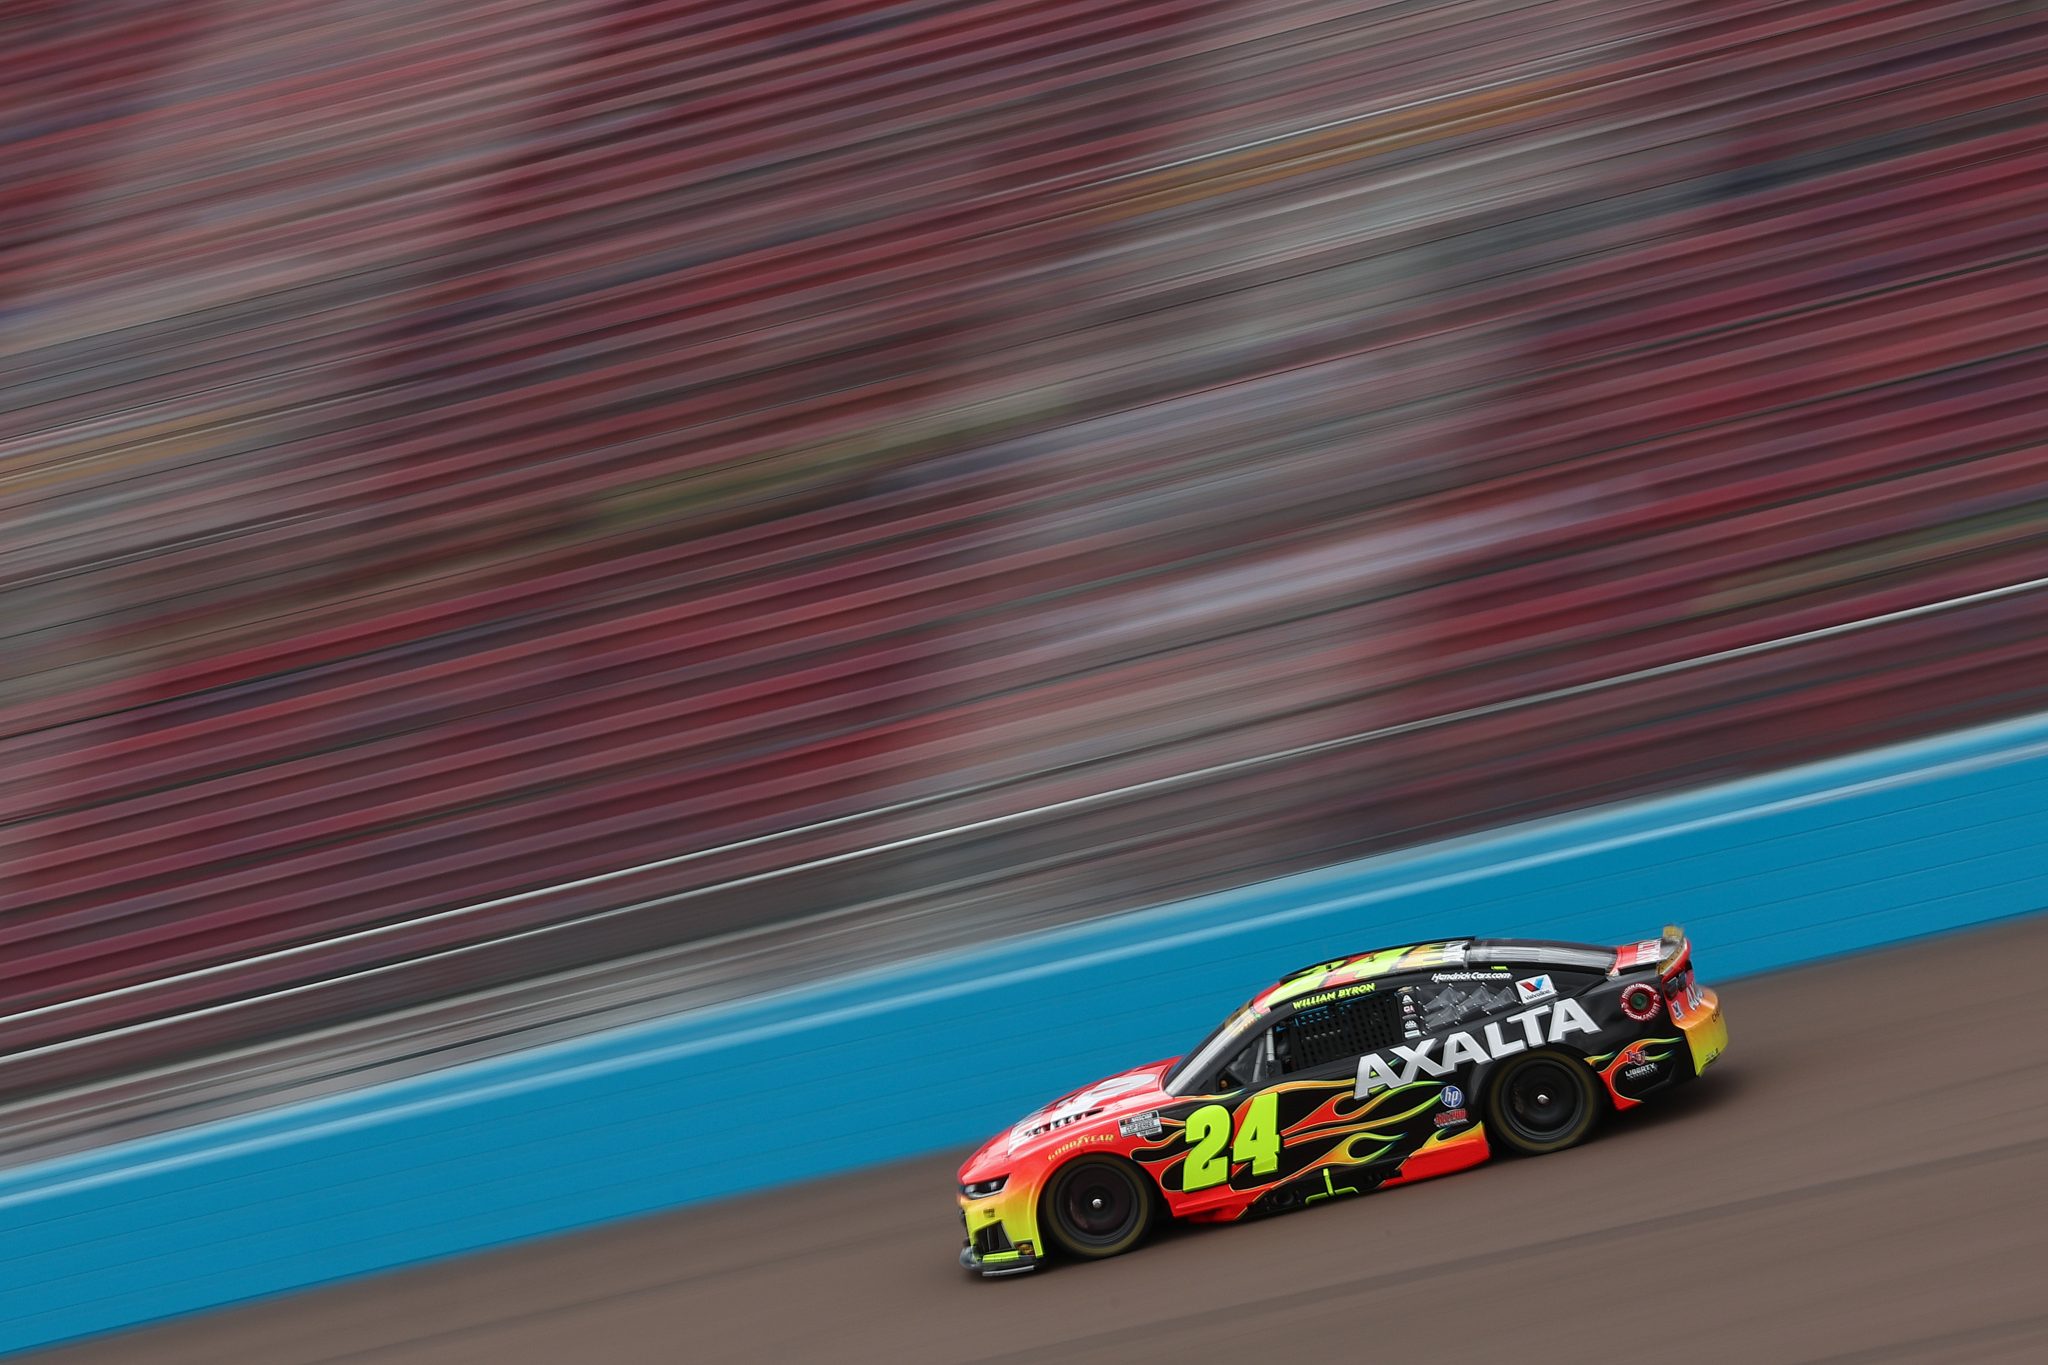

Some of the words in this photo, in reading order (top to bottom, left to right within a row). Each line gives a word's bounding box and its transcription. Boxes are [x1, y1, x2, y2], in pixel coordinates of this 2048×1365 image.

[1292, 991, 1336, 1010] WILLIAM
[1338, 982, 1377, 998] BYRON
[1353, 998, 1602, 1100] AXALTA
[1625, 1063, 1656, 1077] LIBERTY
[1445, 1087, 1459, 1107] hp
[1047, 1134, 1115, 1161] GOODYEAR
[1183, 1092, 1281, 1193] 24
